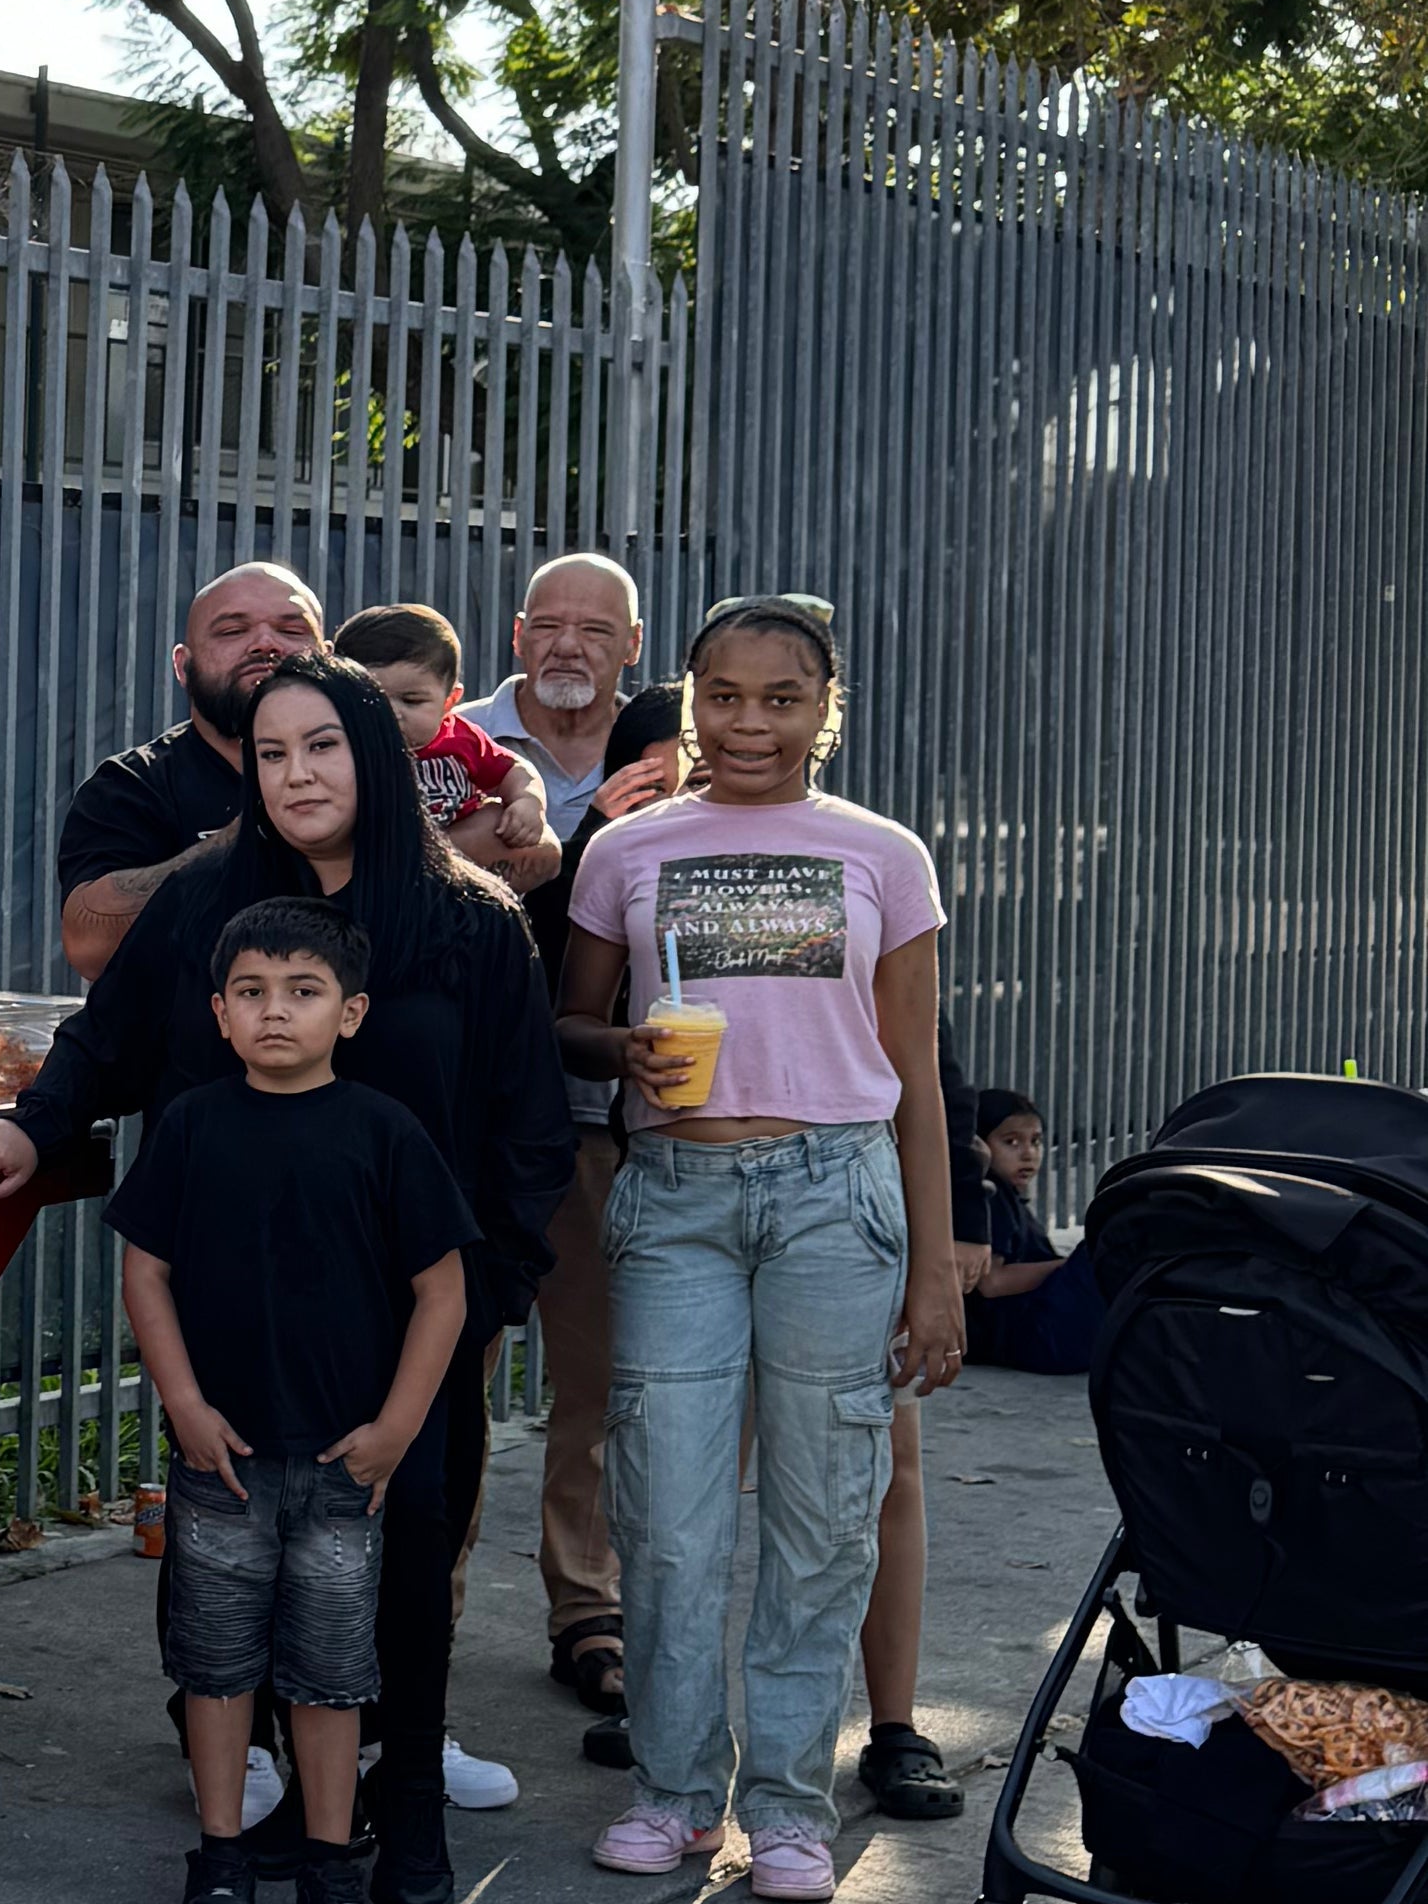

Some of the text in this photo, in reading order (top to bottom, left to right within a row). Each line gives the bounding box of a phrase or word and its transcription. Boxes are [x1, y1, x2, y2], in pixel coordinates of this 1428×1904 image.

[691, 868, 758, 880] MUST
[768, 867, 831, 880] HAVE
[671, 921, 720, 937] AND
